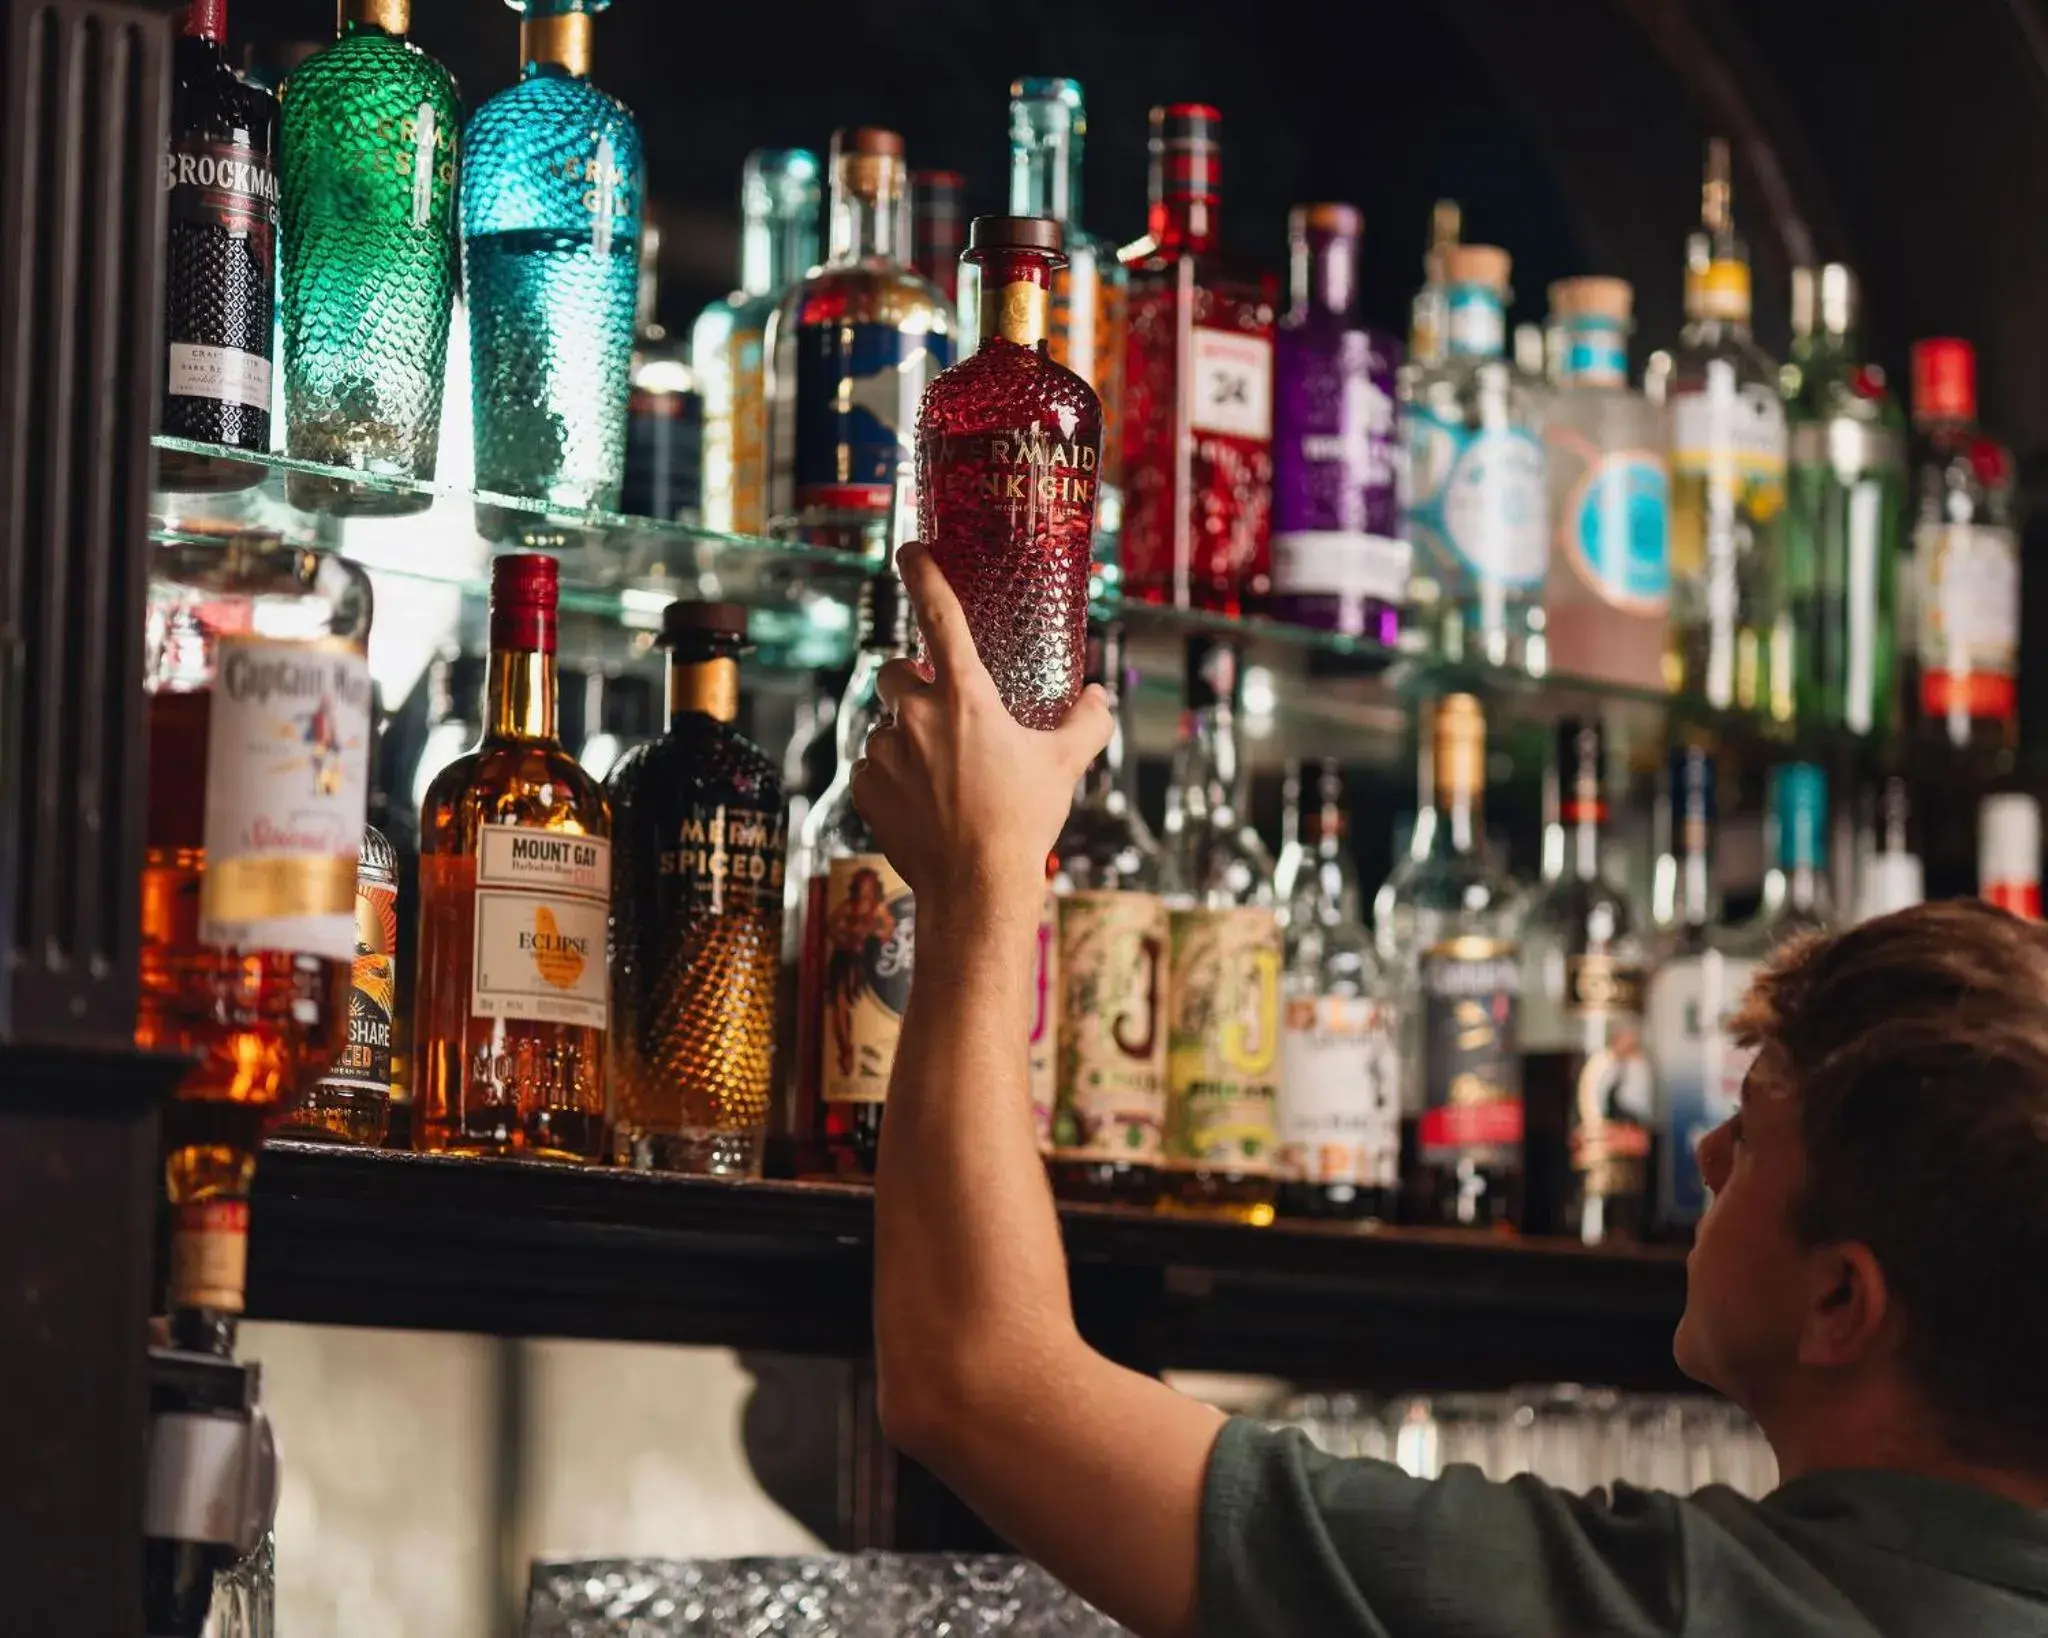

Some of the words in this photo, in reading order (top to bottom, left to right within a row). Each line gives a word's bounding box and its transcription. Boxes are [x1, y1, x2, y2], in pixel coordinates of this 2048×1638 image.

[1037, 476, 1088, 503] GIN
[678, 818, 783, 848] MERMA
[511, 838, 571, 863] MOUNT
[573, 845, 596, 868] GAY
[659, 848, 766, 880] SPICED
[518, 931, 589, 956] ECLIPSE
[348, 1019, 390, 1048] SHARE
